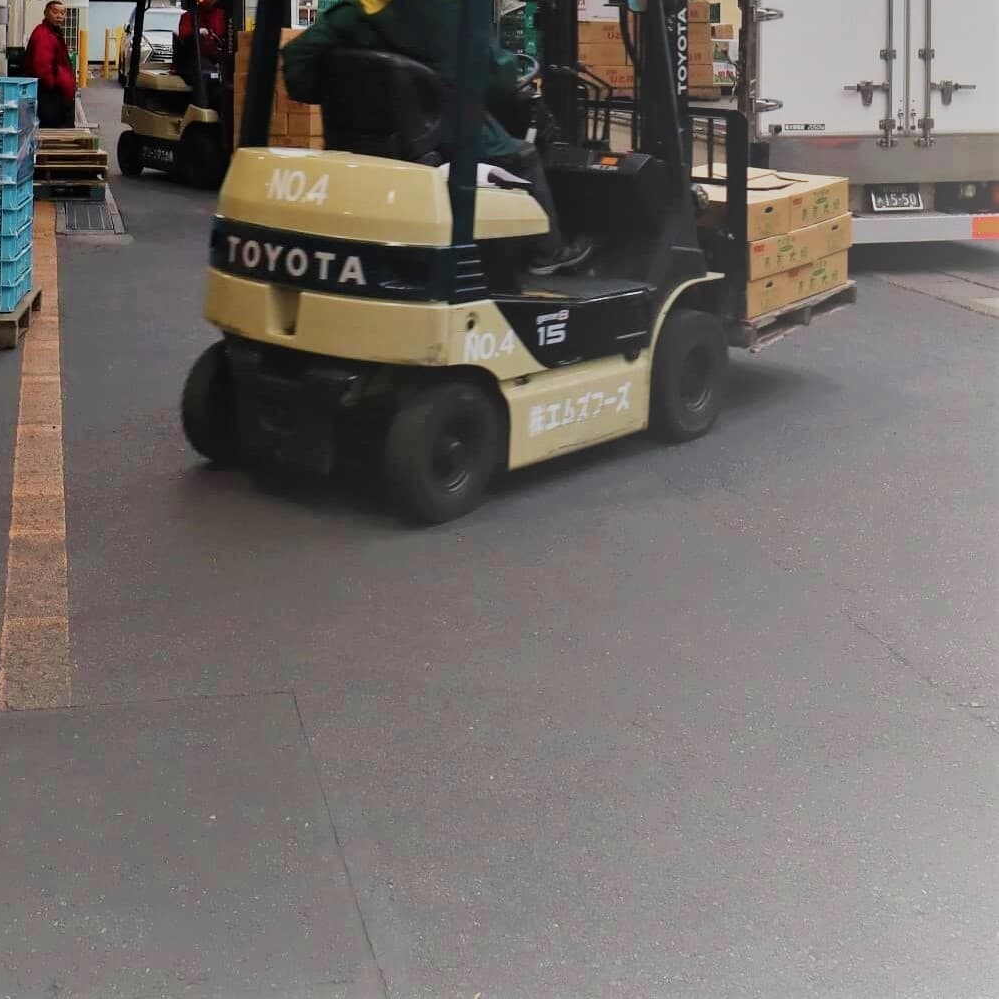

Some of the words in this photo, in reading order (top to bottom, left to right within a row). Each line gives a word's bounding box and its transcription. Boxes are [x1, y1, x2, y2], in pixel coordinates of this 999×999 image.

[677, 7, 688, 96] TOYOTA
[267, 167, 330, 206] NO.4
[226, 235, 367, 286] TOYOTA
[464, 327, 516, 361] NO.4
[536, 322, 567, 346] 15
